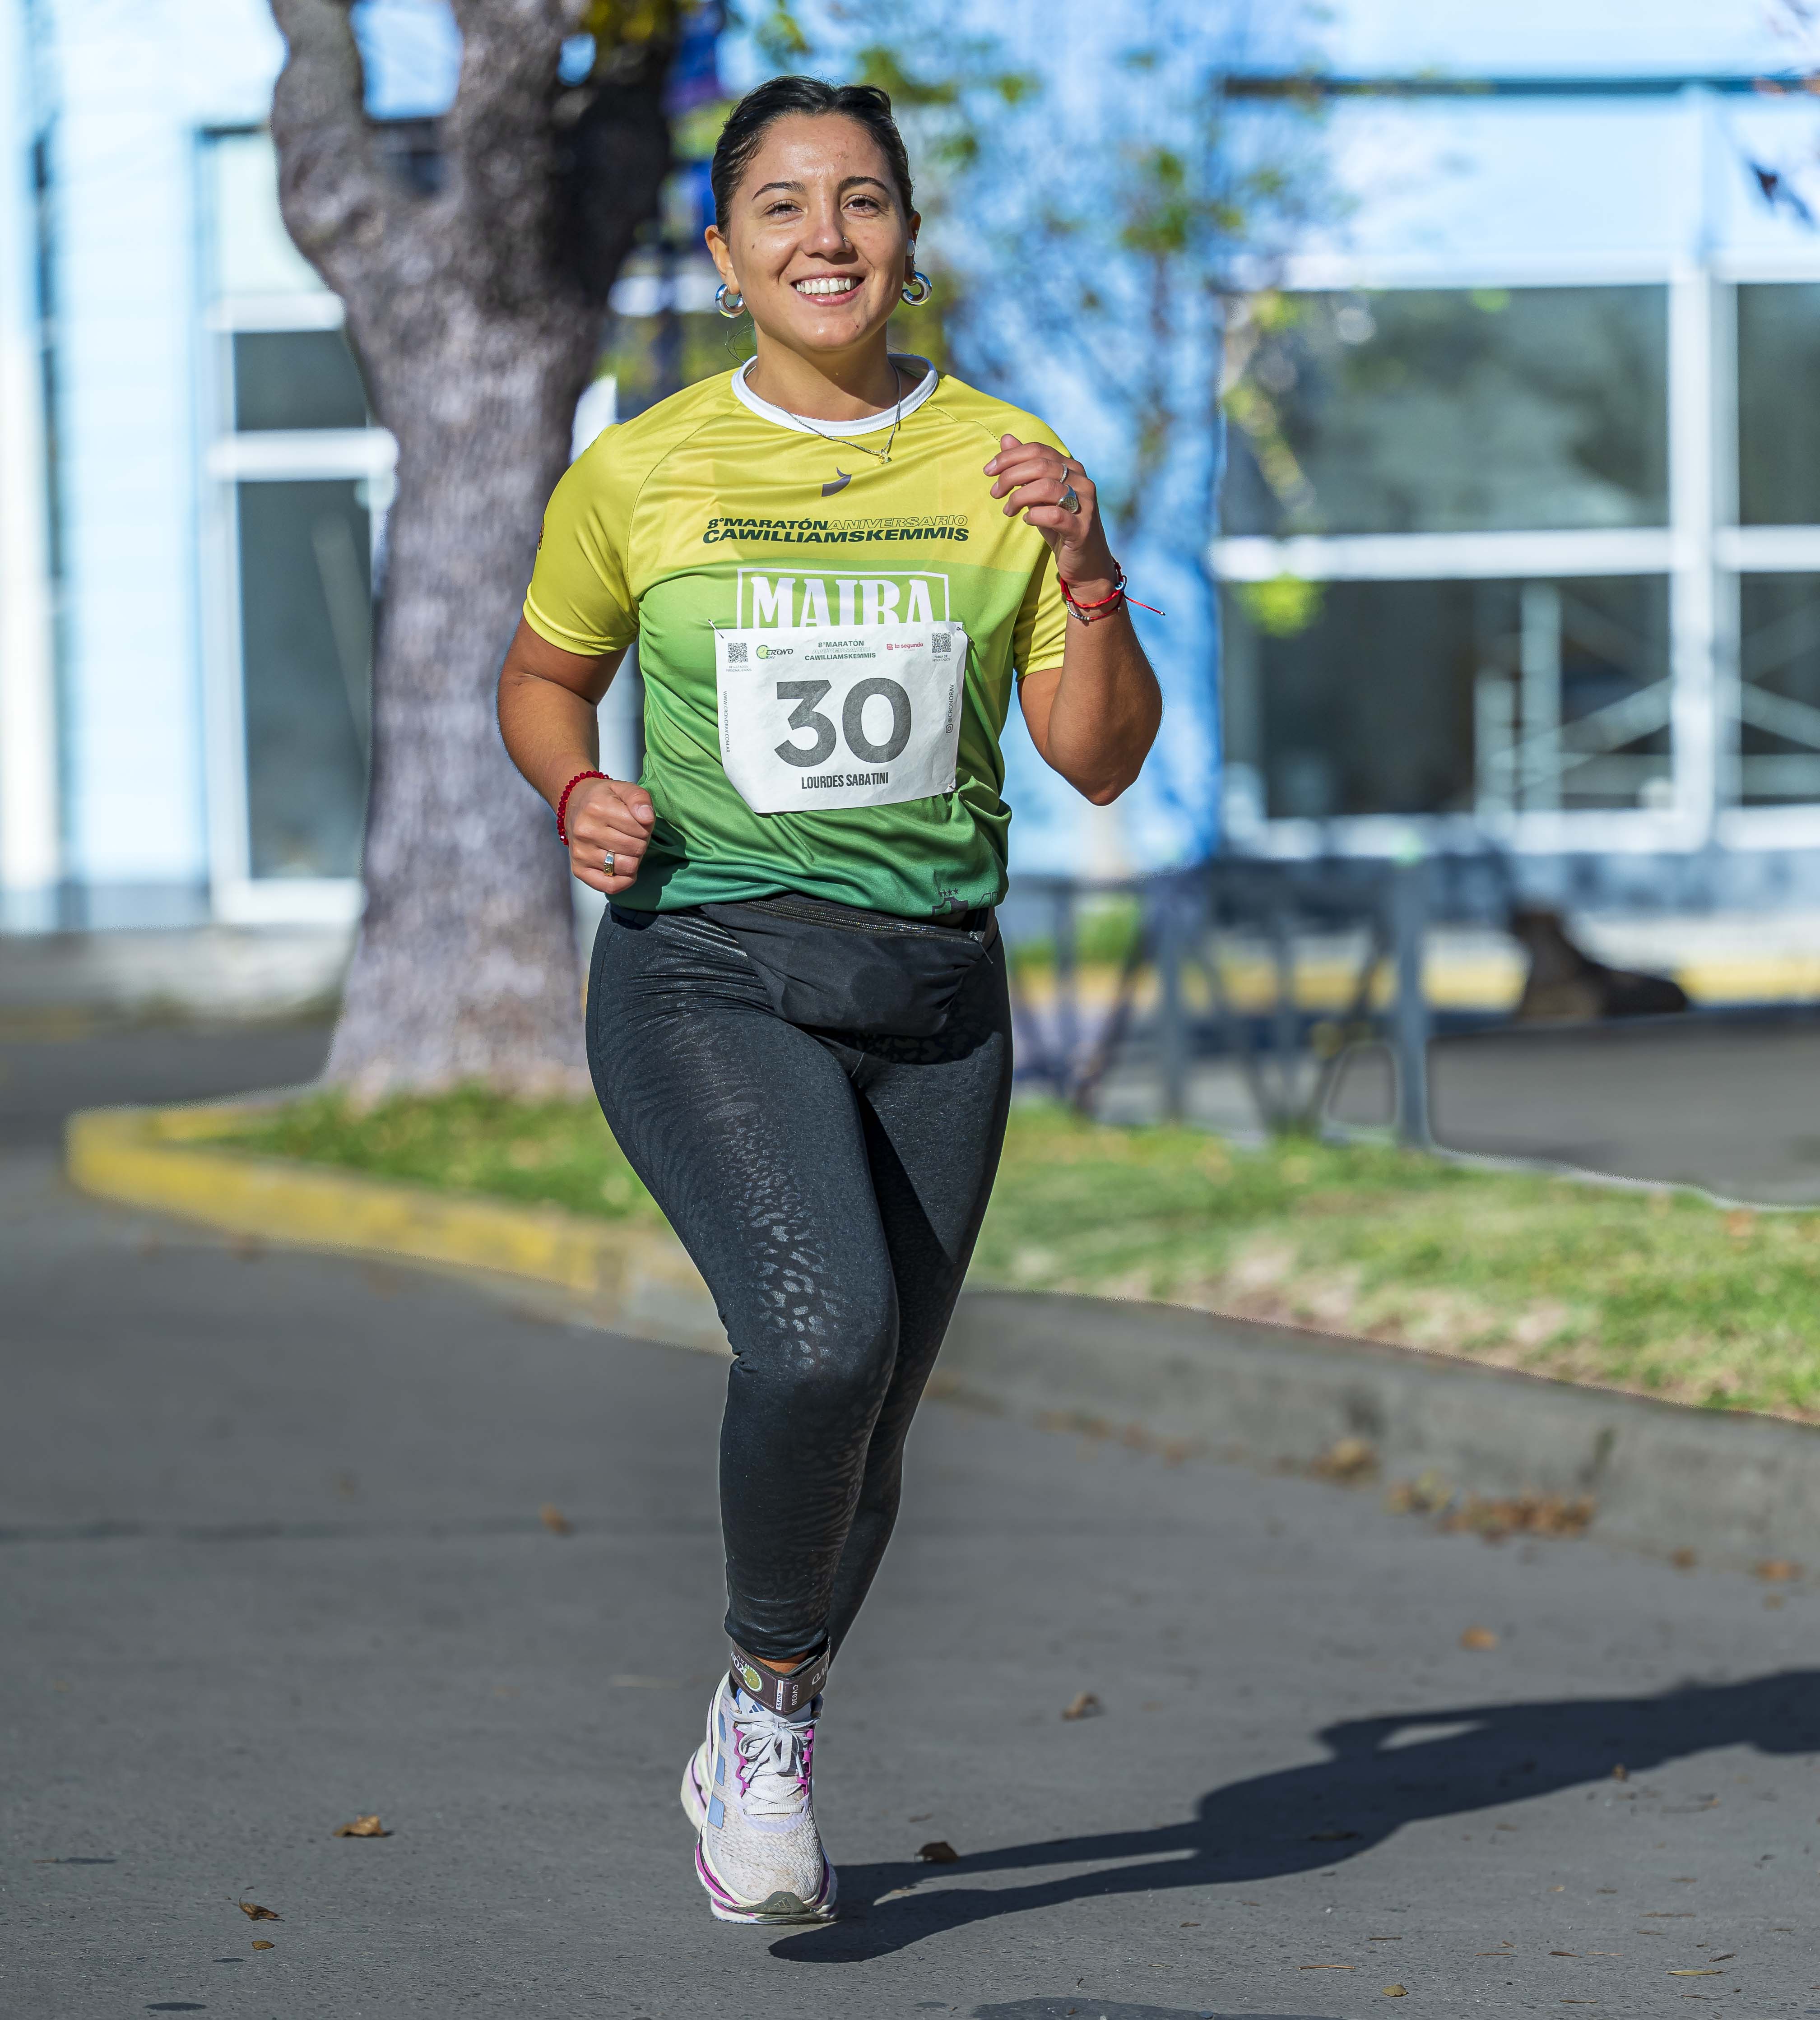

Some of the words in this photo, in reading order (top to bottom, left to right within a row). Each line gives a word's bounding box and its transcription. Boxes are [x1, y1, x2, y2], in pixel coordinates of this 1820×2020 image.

[703, 527, 969, 544] CAWILLIAMSKEMMIS
[805, 653, 876, 661] CAWILLIAMSKEMMIS
[774, 677, 912, 767] 30
[802, 774, 844, 789] LOURDES
[846, 772, 889, 787] SABATINI
